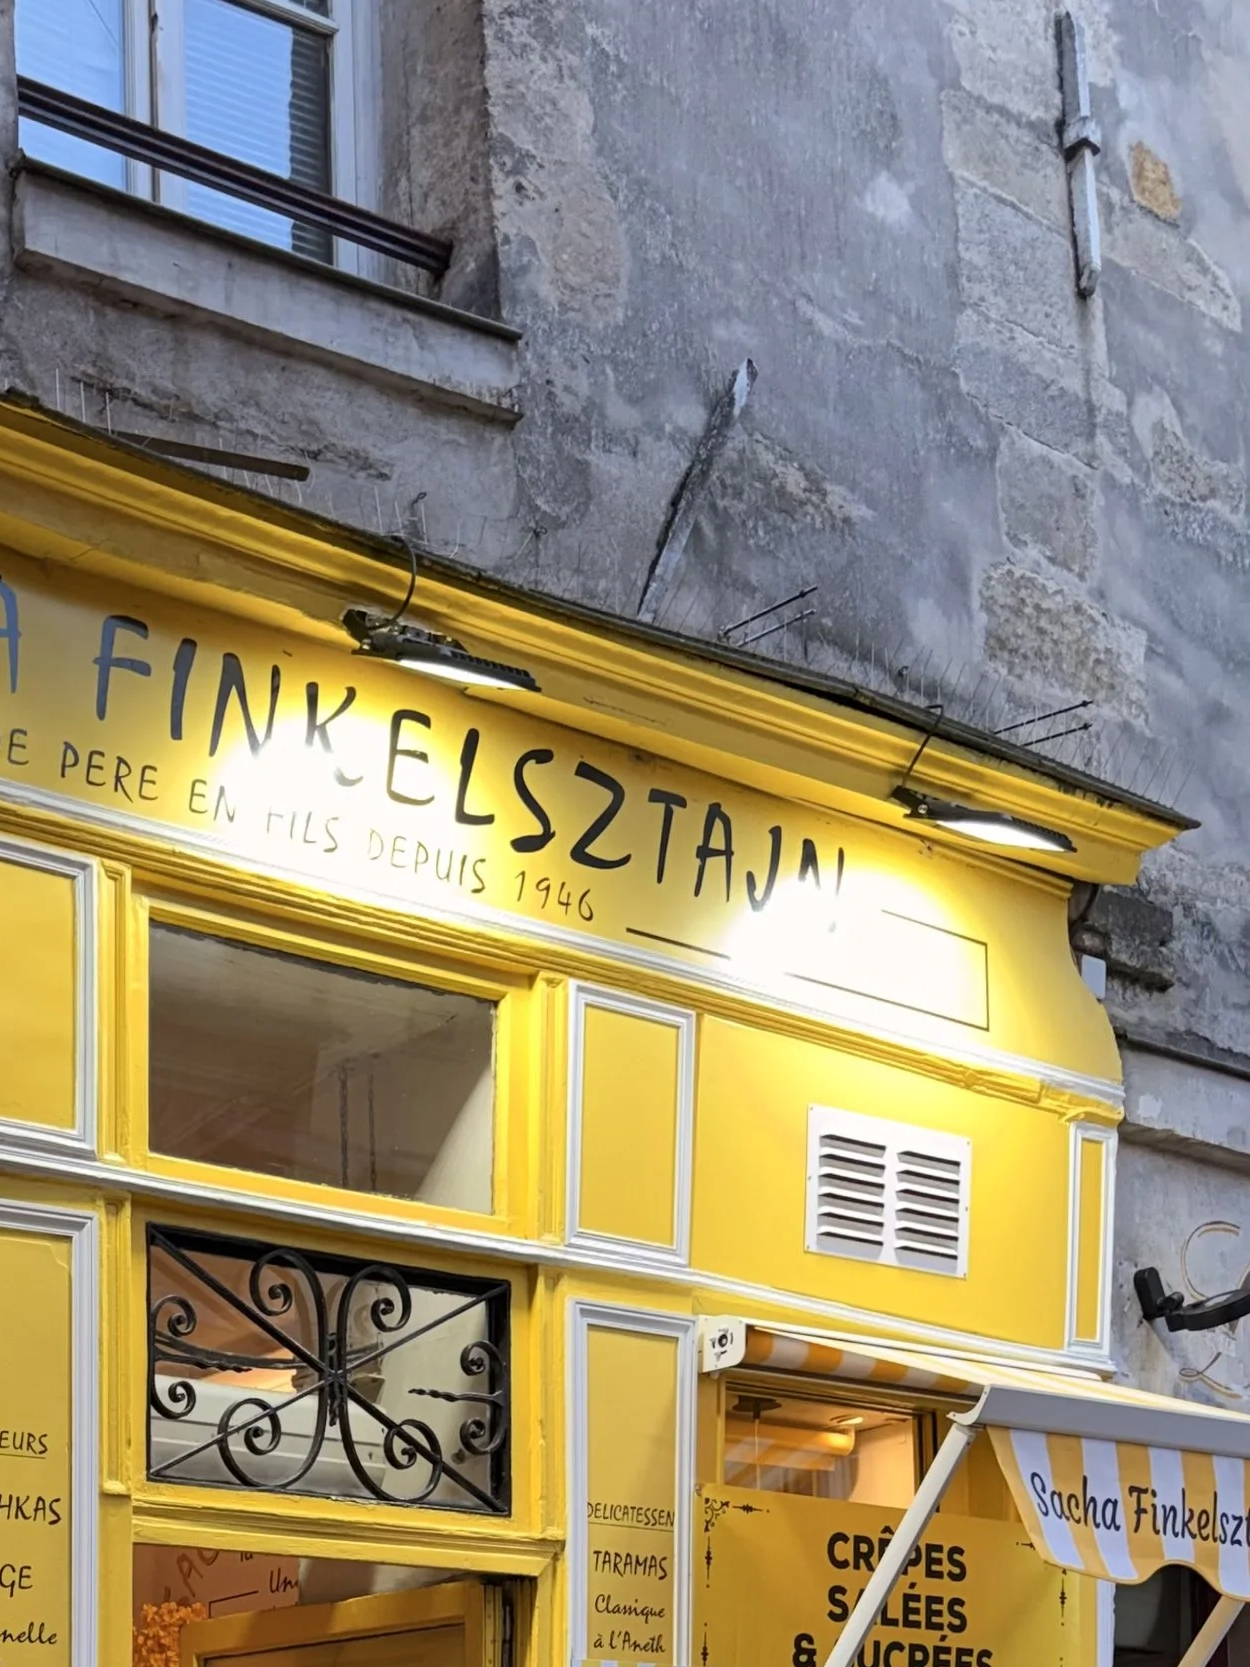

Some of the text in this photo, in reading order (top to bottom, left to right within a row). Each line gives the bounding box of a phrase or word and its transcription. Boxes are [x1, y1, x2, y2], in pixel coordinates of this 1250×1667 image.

[94, 614, 847, 933] FINKELSZTAJN
[59, 739, 161, 804] PERE
[187, 783, 237, 825] EN
[264, 802, 339, 854] FILS
[367, 827, 489, 895] DEPUIS
[512, 869, 596, 922] 1946
[587, 1502, 674, 1528] DELICATESSEN
[1030, 1471, 1121, 1532] Sacha
[593, 1550, 668, 1581] TARAMAS
[827, 1525, 968, 1583] CRPES
[594, 1593, 666, 1625] Classique
[827, 1582, 969, 1634] SLÉES
[593, 1633, 604, 1649] à
